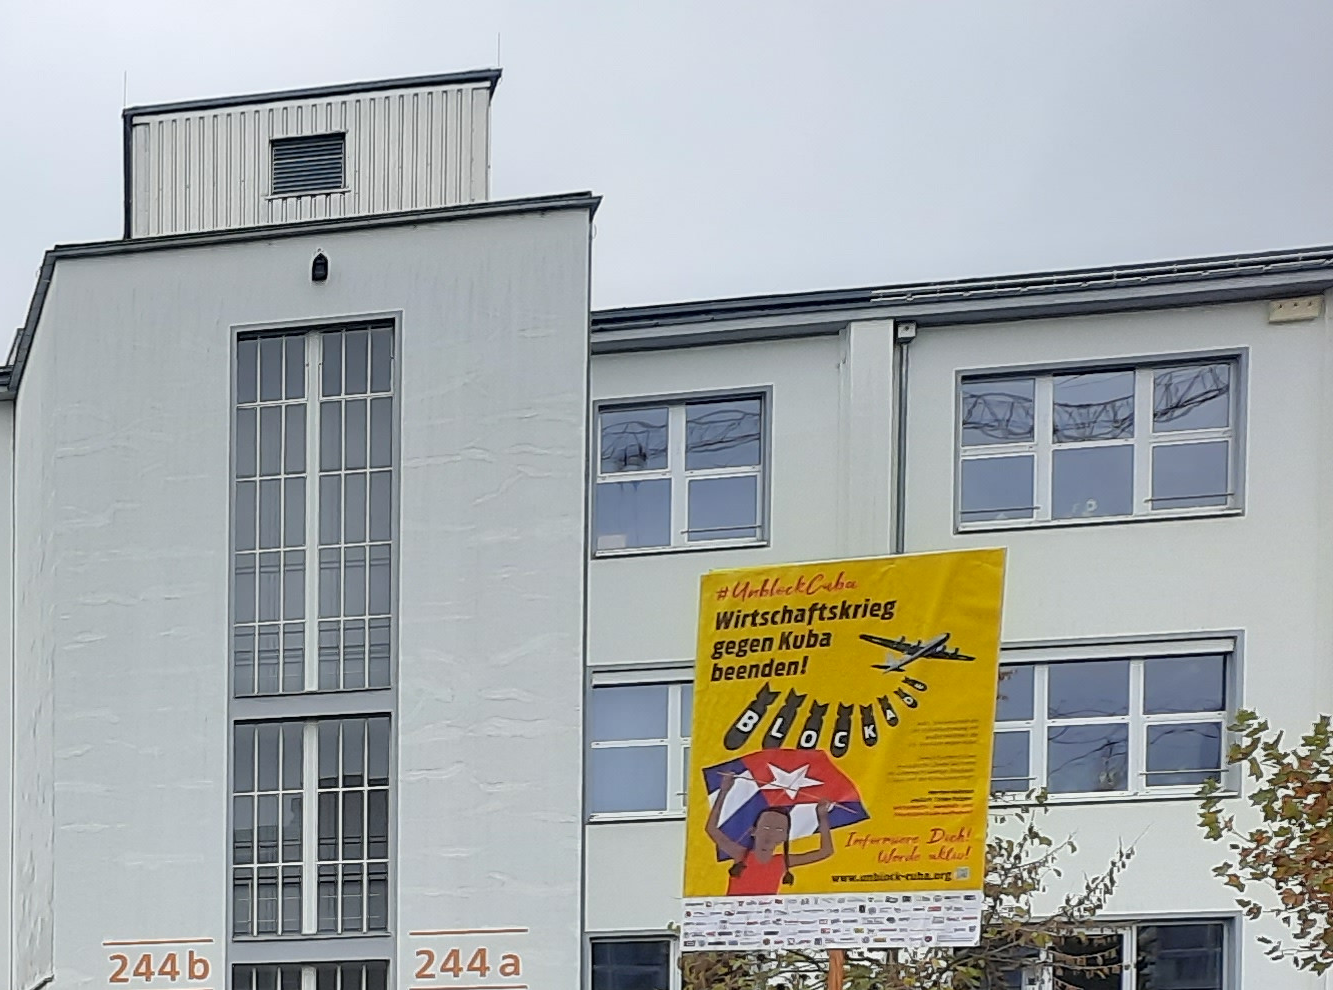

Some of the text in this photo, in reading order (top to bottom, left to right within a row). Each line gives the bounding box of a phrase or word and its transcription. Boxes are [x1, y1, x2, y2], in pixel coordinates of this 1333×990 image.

[716, 571, 858, 601] #UnblockCuba
[715, 599, 897, 630] Wirtschaftskrieg
[711, 629, 832, 660] gegen Kuba
[710, 656, 810, 682] beenden!
[108, 948, 211, 984] 244 b
[414, 947, 522, 979] 244 a
